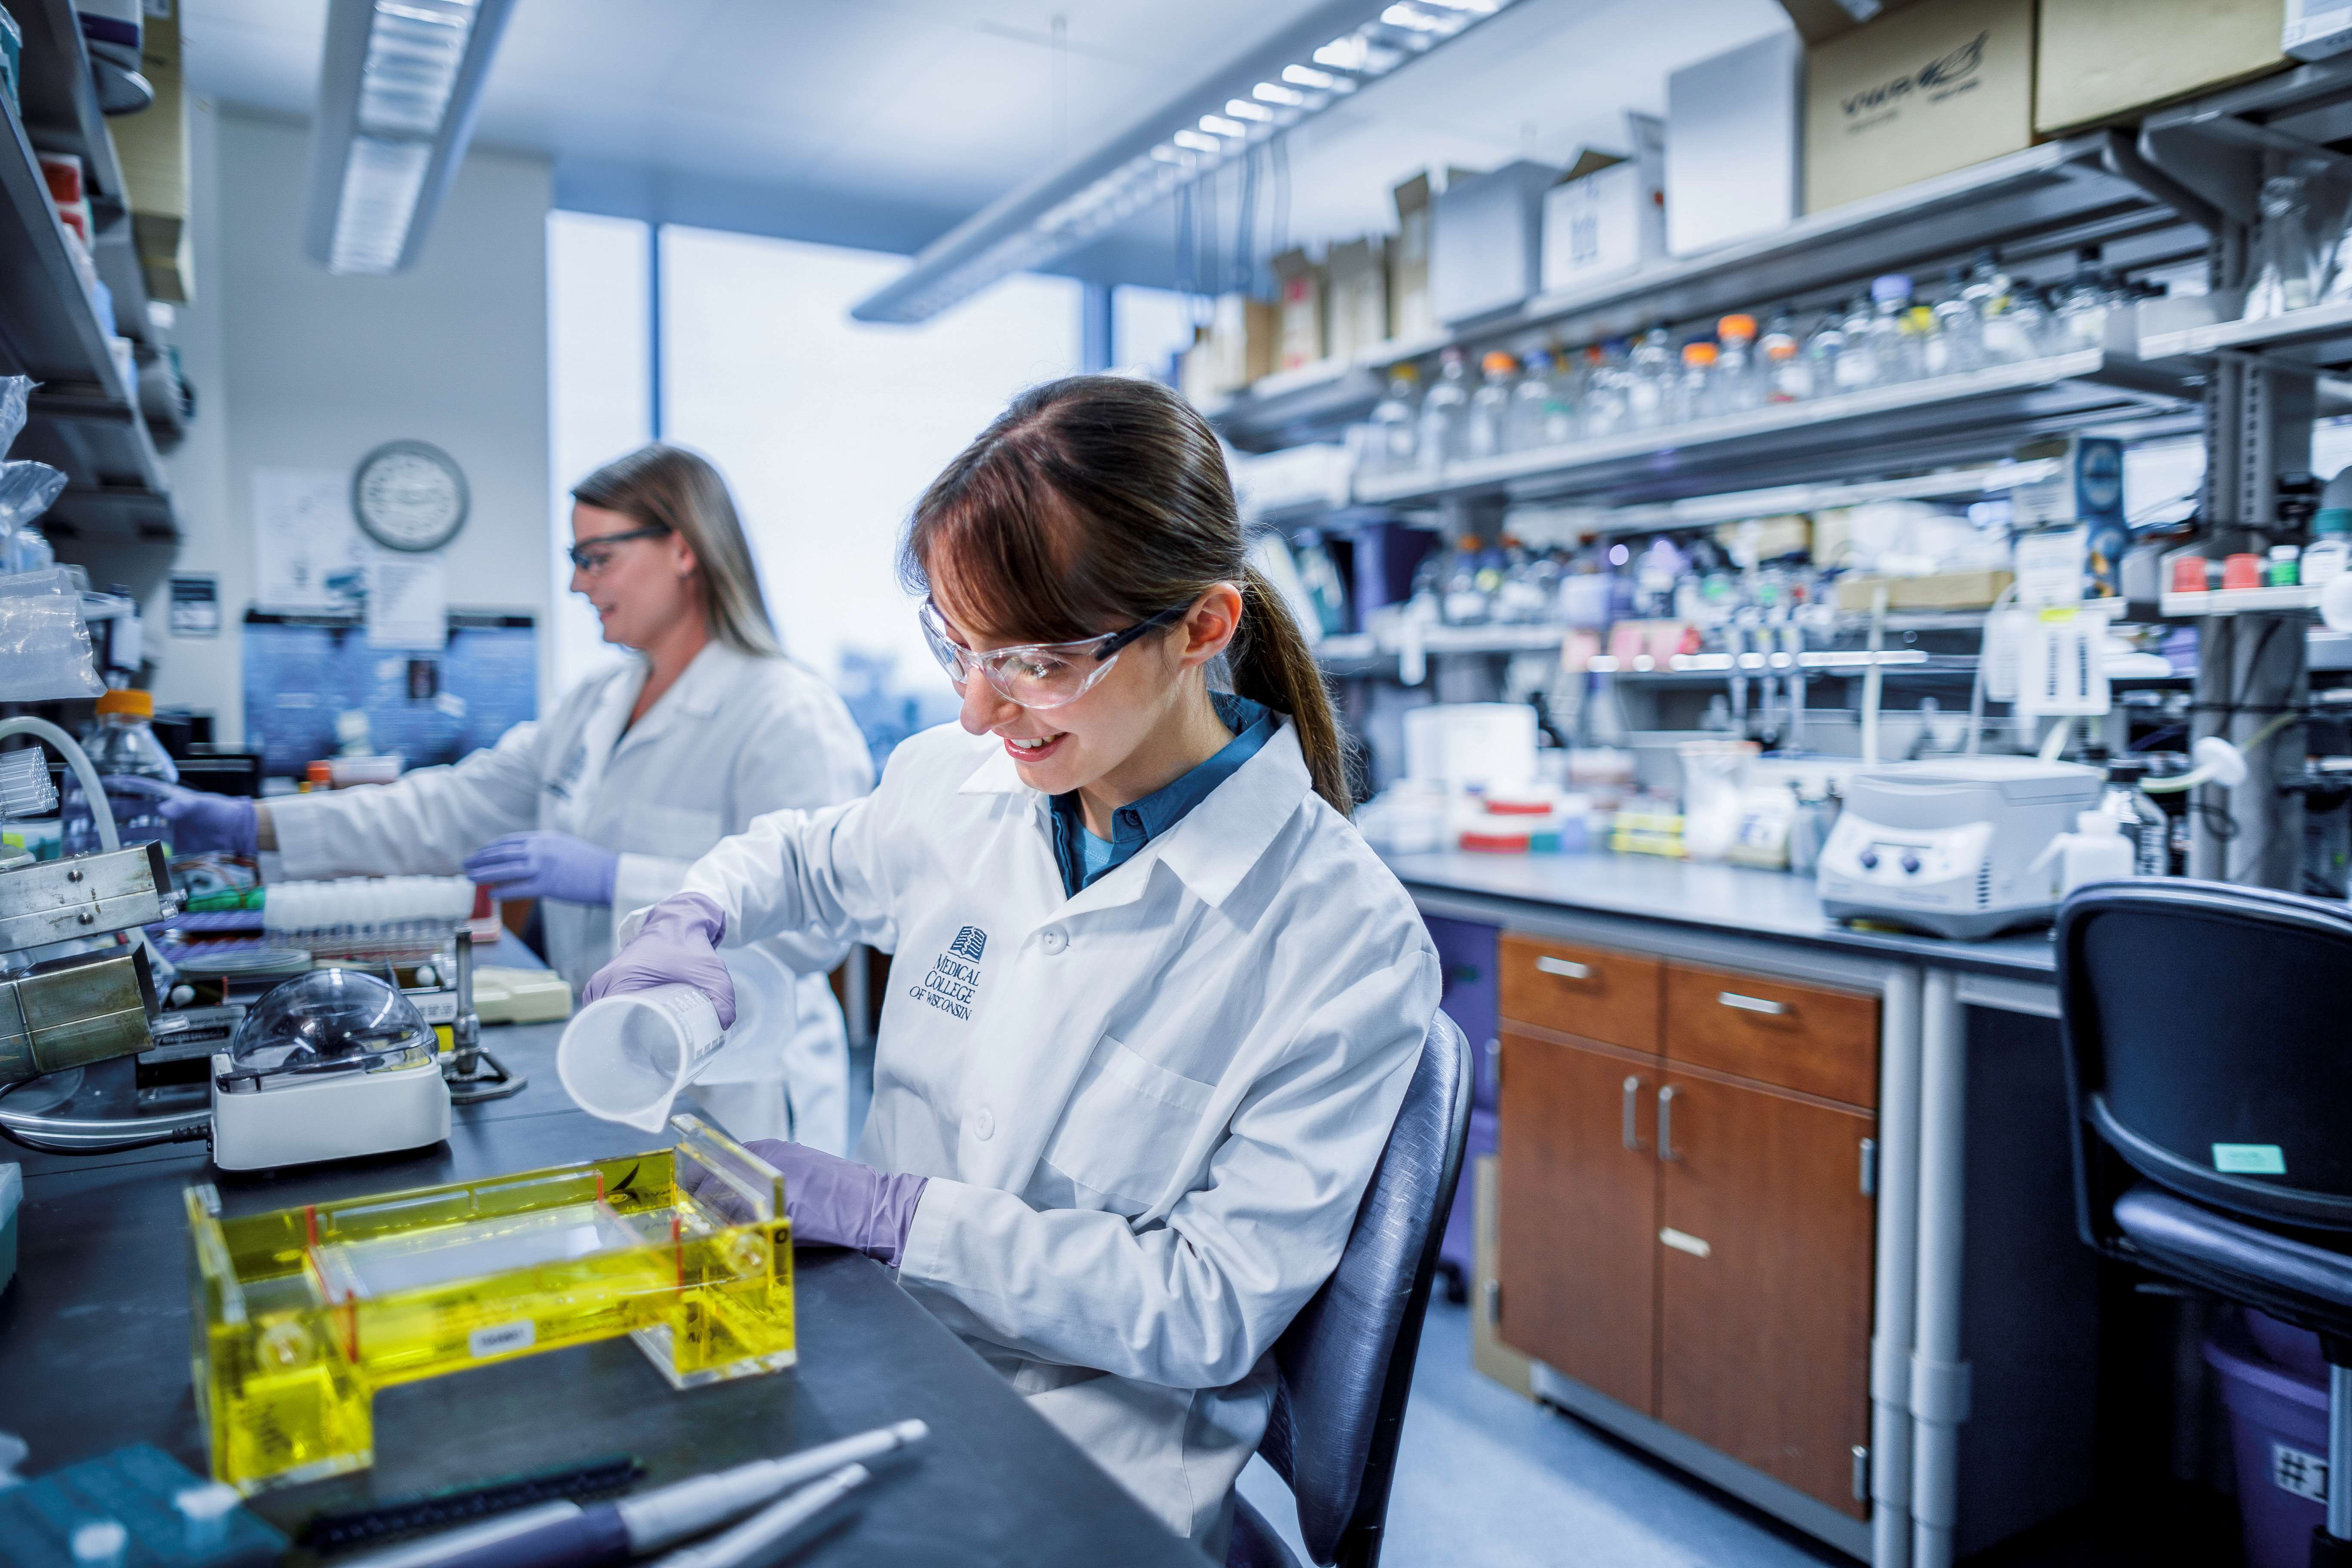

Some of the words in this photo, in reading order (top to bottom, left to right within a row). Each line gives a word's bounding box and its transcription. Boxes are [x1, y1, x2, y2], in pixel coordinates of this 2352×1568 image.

[933, 953, 980, 986] MEDICAL
[910, 986, 926, 1000] OF
[927, 992, 972, 1021] WISCONSIN
[925, 970, 975, 1004] COLLEGE
